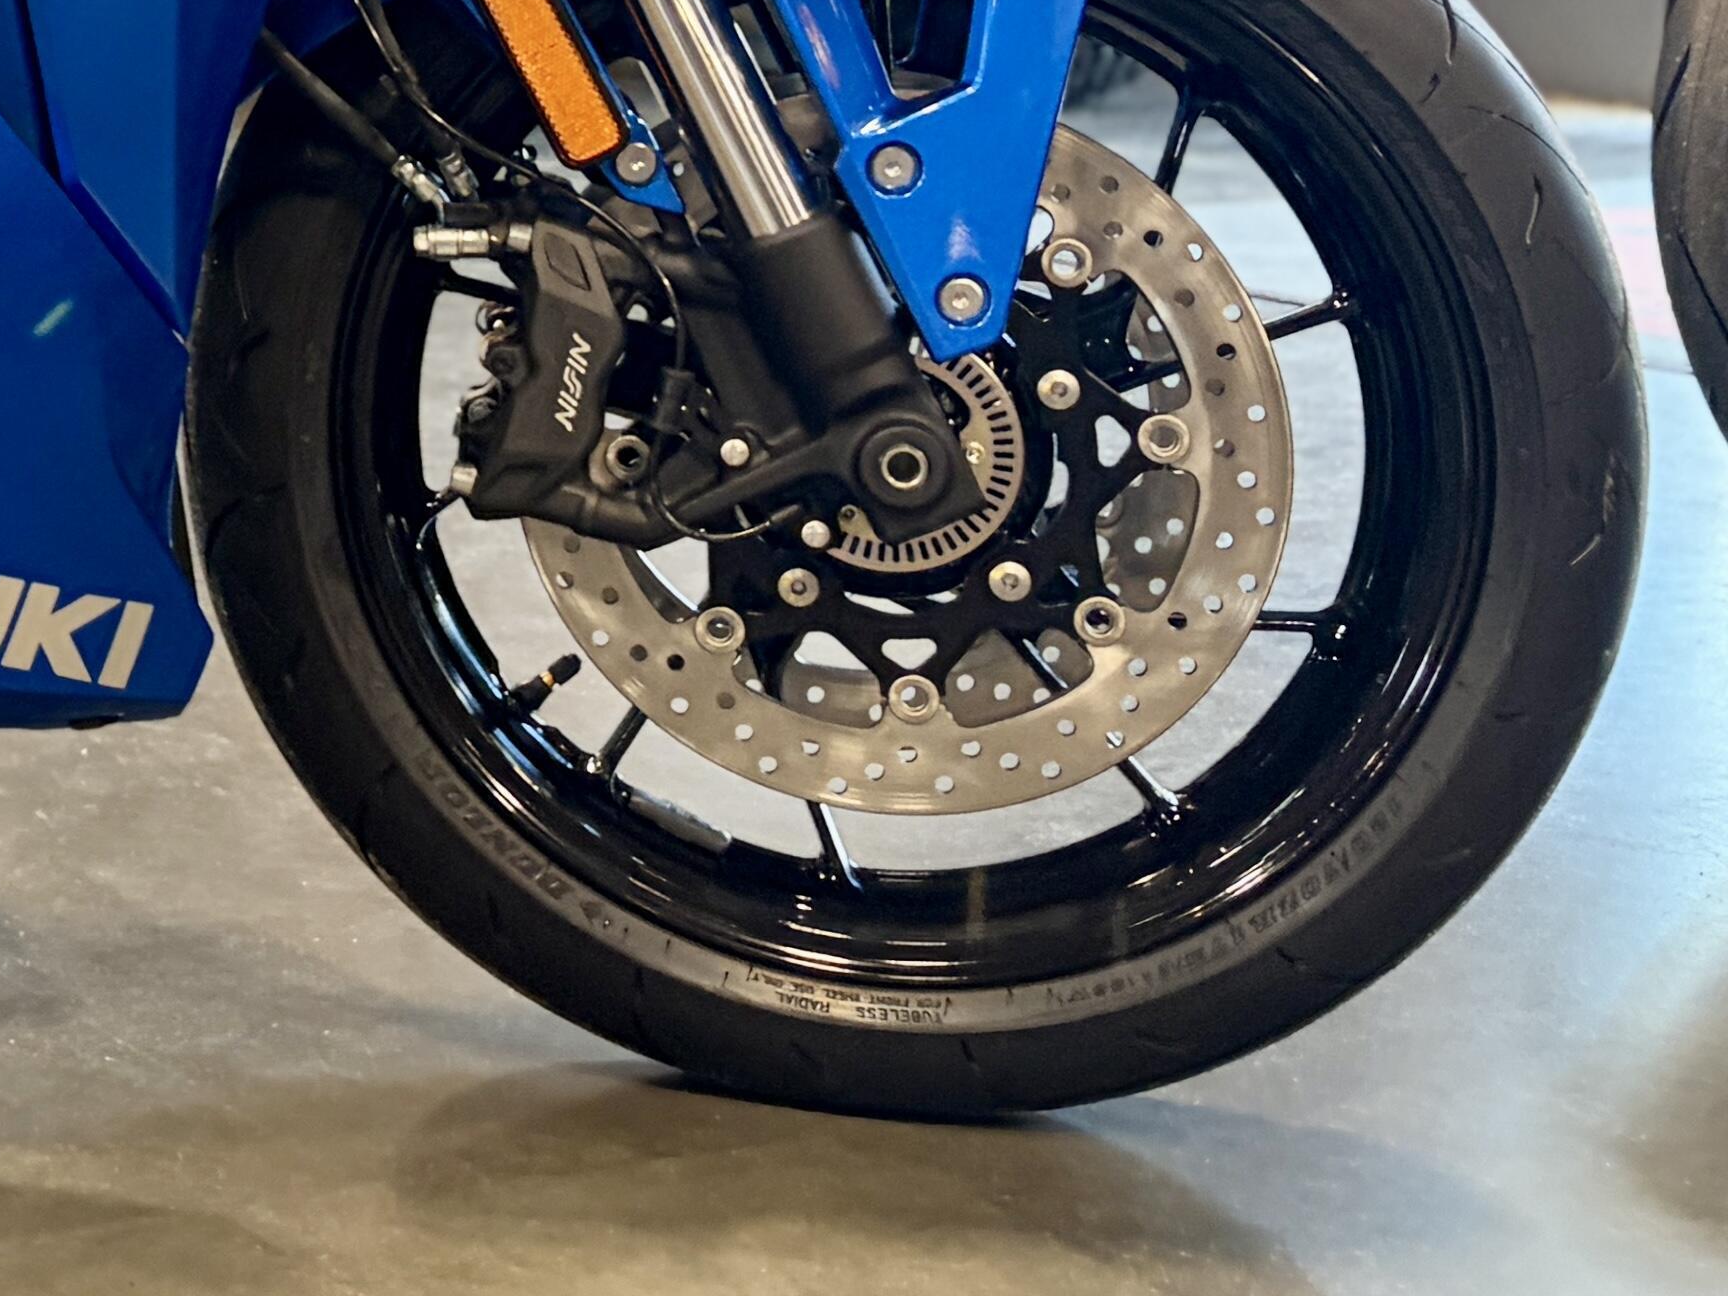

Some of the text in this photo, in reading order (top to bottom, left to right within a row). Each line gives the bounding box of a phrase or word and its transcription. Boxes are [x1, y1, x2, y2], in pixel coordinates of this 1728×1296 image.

[553, 331, 592, 433] NISSIN
[773, 991, 943, 1024] TUBELESS RADIAL
